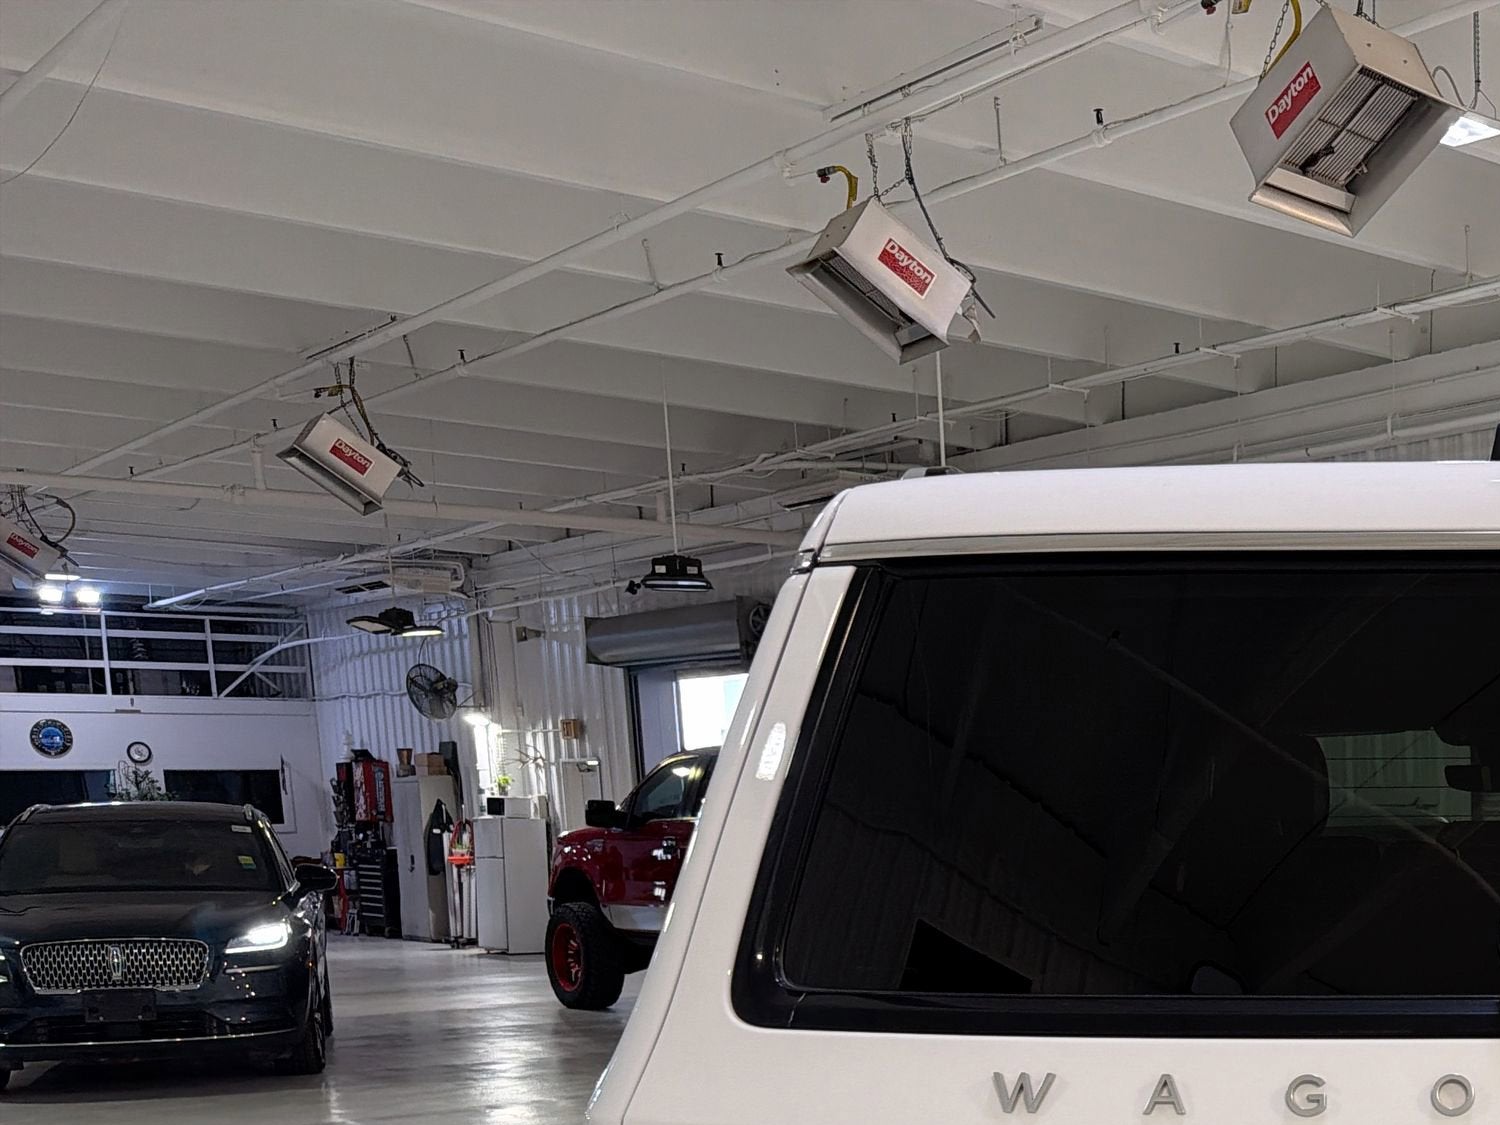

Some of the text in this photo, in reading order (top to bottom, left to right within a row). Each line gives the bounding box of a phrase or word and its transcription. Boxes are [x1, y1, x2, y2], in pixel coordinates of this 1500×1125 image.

[1267, 66, 1314, 125] Dayton
[885, 240, 932, 284] Dayton
[334, 440, 371, 468] Dayton
